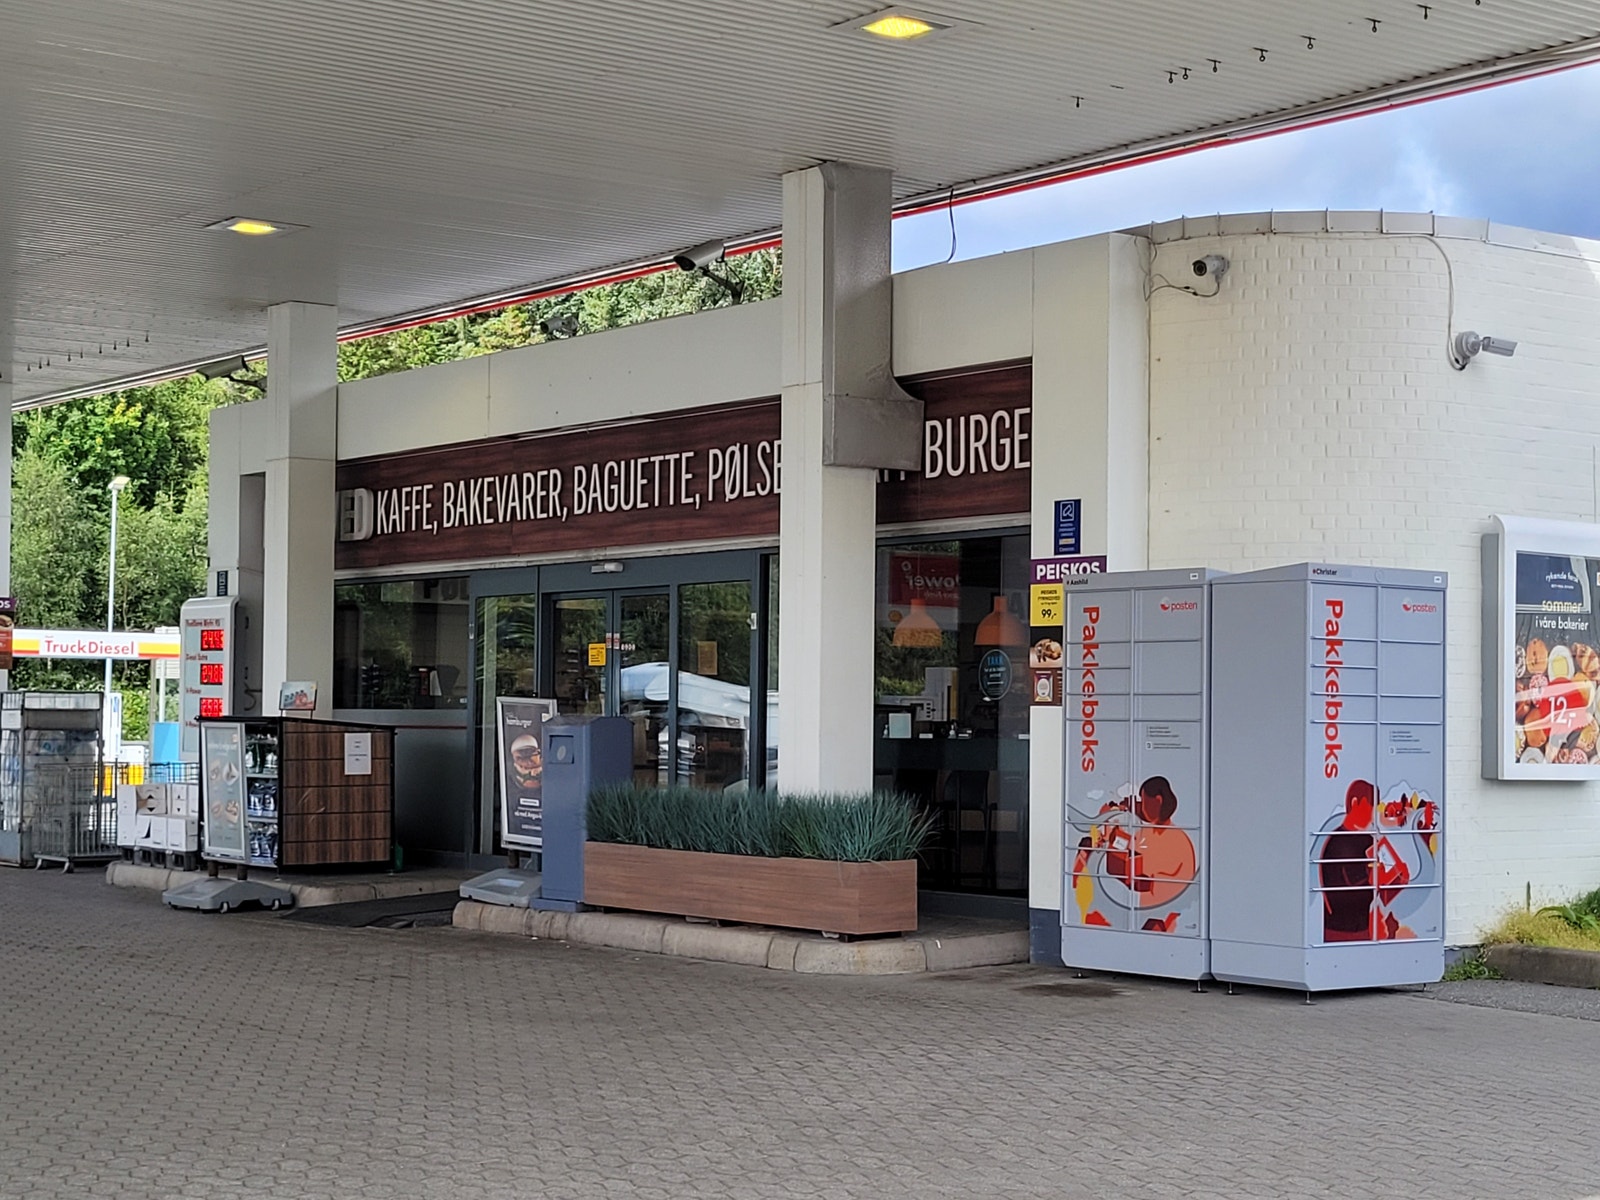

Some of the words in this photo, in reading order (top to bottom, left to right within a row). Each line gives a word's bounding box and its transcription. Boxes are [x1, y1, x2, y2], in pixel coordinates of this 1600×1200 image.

[377, 484, 438, 535] KAFFE,
[443, 468, 568, 529] BAKEVARER,
[573, 451, 701, 515] BAGUETTE,
[925, 407, 1031, 479] BURGE
[1036, 561, 1100, 581] PEISKOS
[1041, 608, 1057, 620] 99,-
[1170, 601, 1198, 612] posten
[1412, 603, 1437, 613] posten
[1542, 600, 1582, 613] sommer
[1539, 616, 1556, 629] våre
[1558, 616, 1589, 631] bakerier
[45, 639, 135, 655] TruckDiesel
[1081, 606, 1100, 773] Pakkeboks
[1324, 599, 1344, 779] Pakkeboks
[1548, 696, 1577, 728] 12,-
